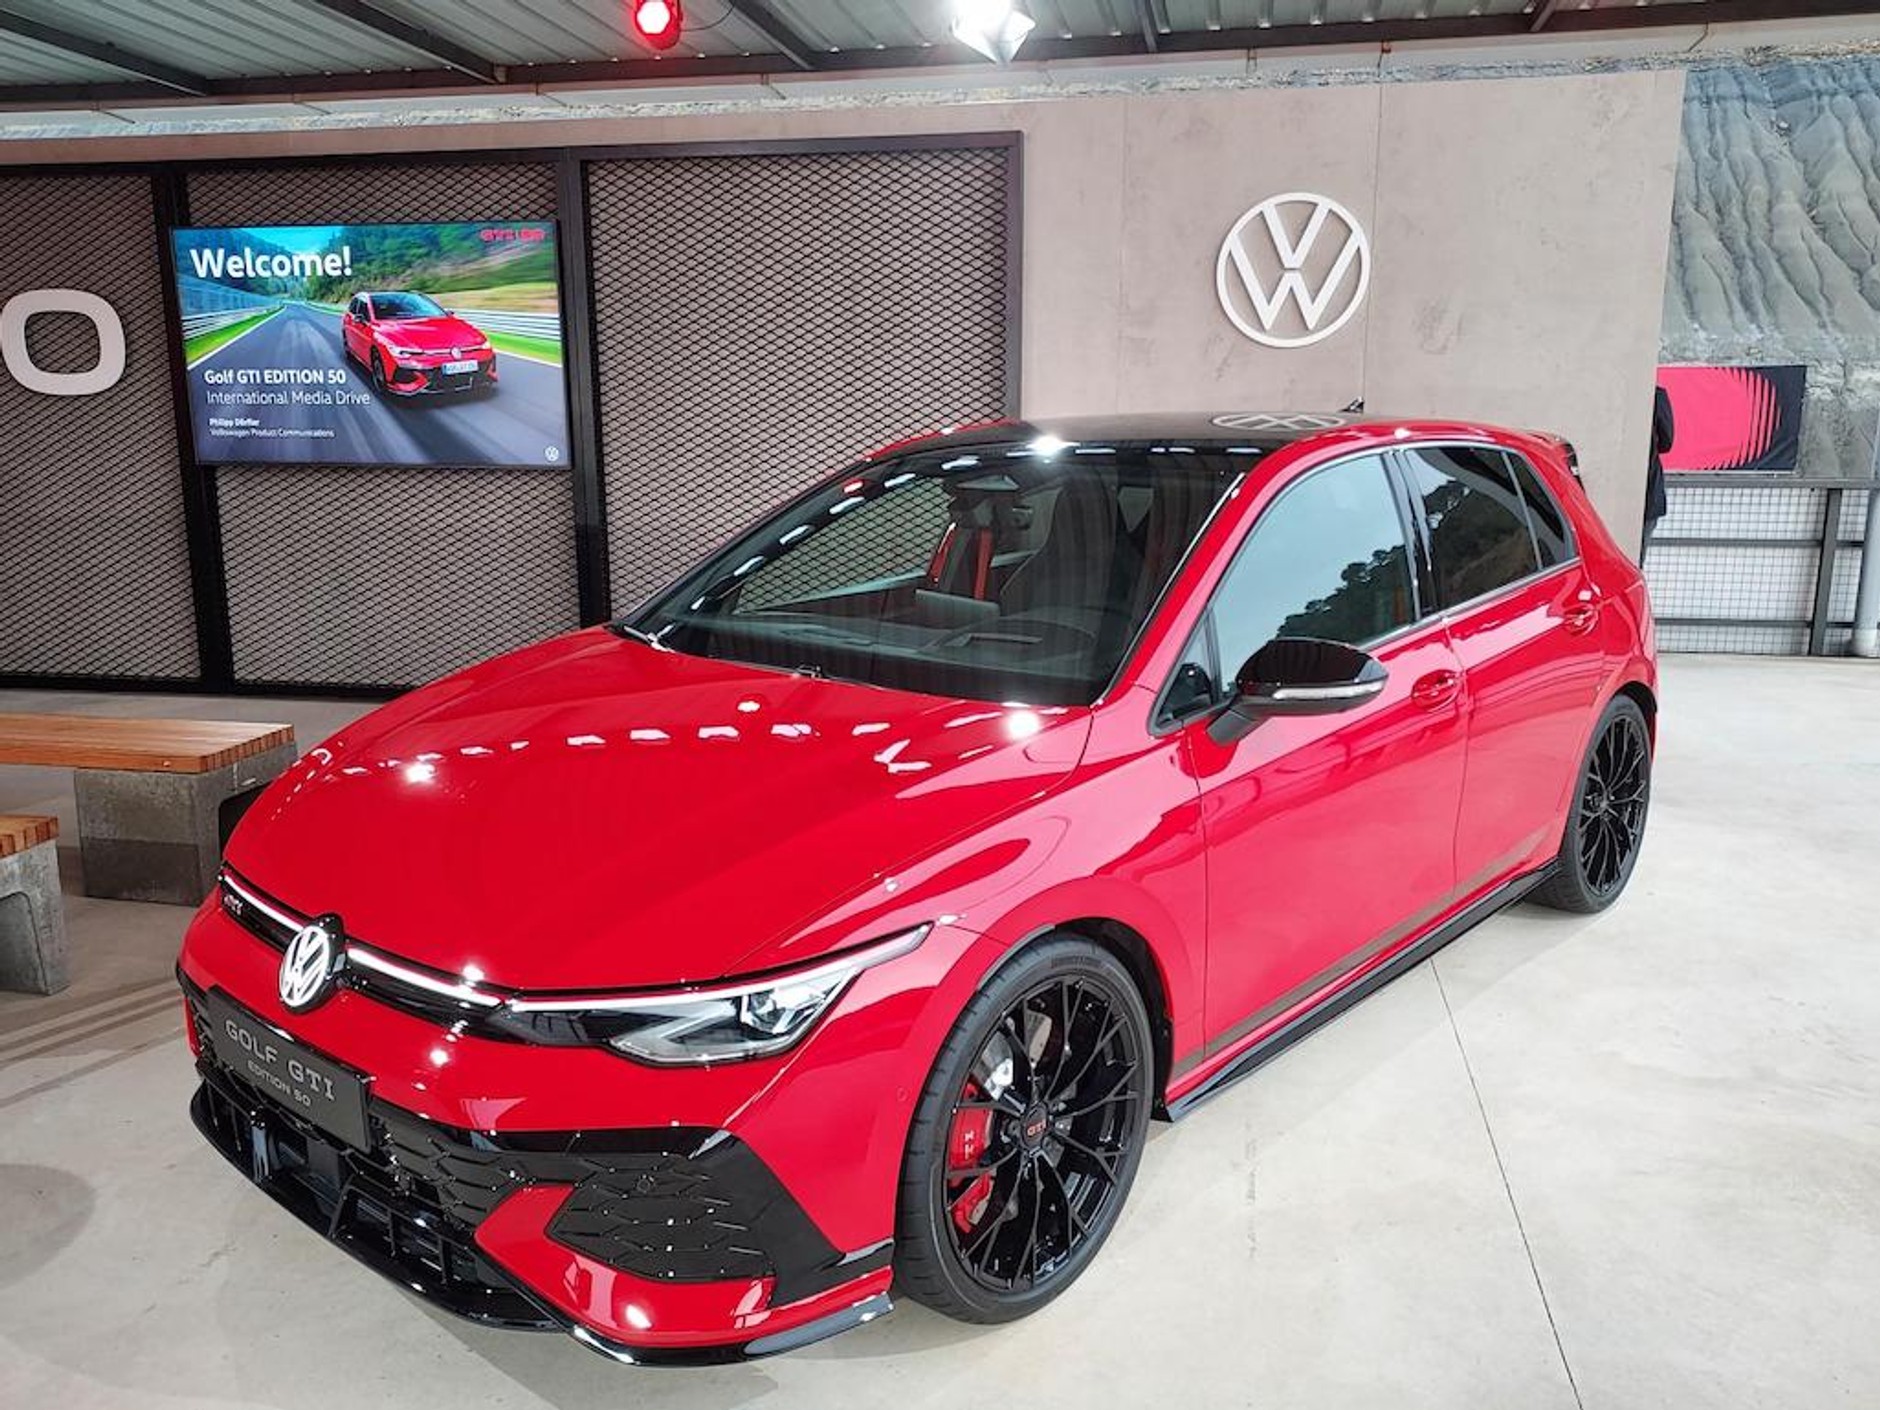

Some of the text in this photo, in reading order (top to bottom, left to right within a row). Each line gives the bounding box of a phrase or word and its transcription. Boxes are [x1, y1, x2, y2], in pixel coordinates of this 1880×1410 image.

[189, 245, 352, 279] Welcome!
[204, 369, 347, 384] Golf GTI EDITION 50
[206, 390, 371, 405] International Media Drive
[225, 1019, 335, 1101] GOLF GTI
[247, 1060, 311, 1107] EDITION 50
